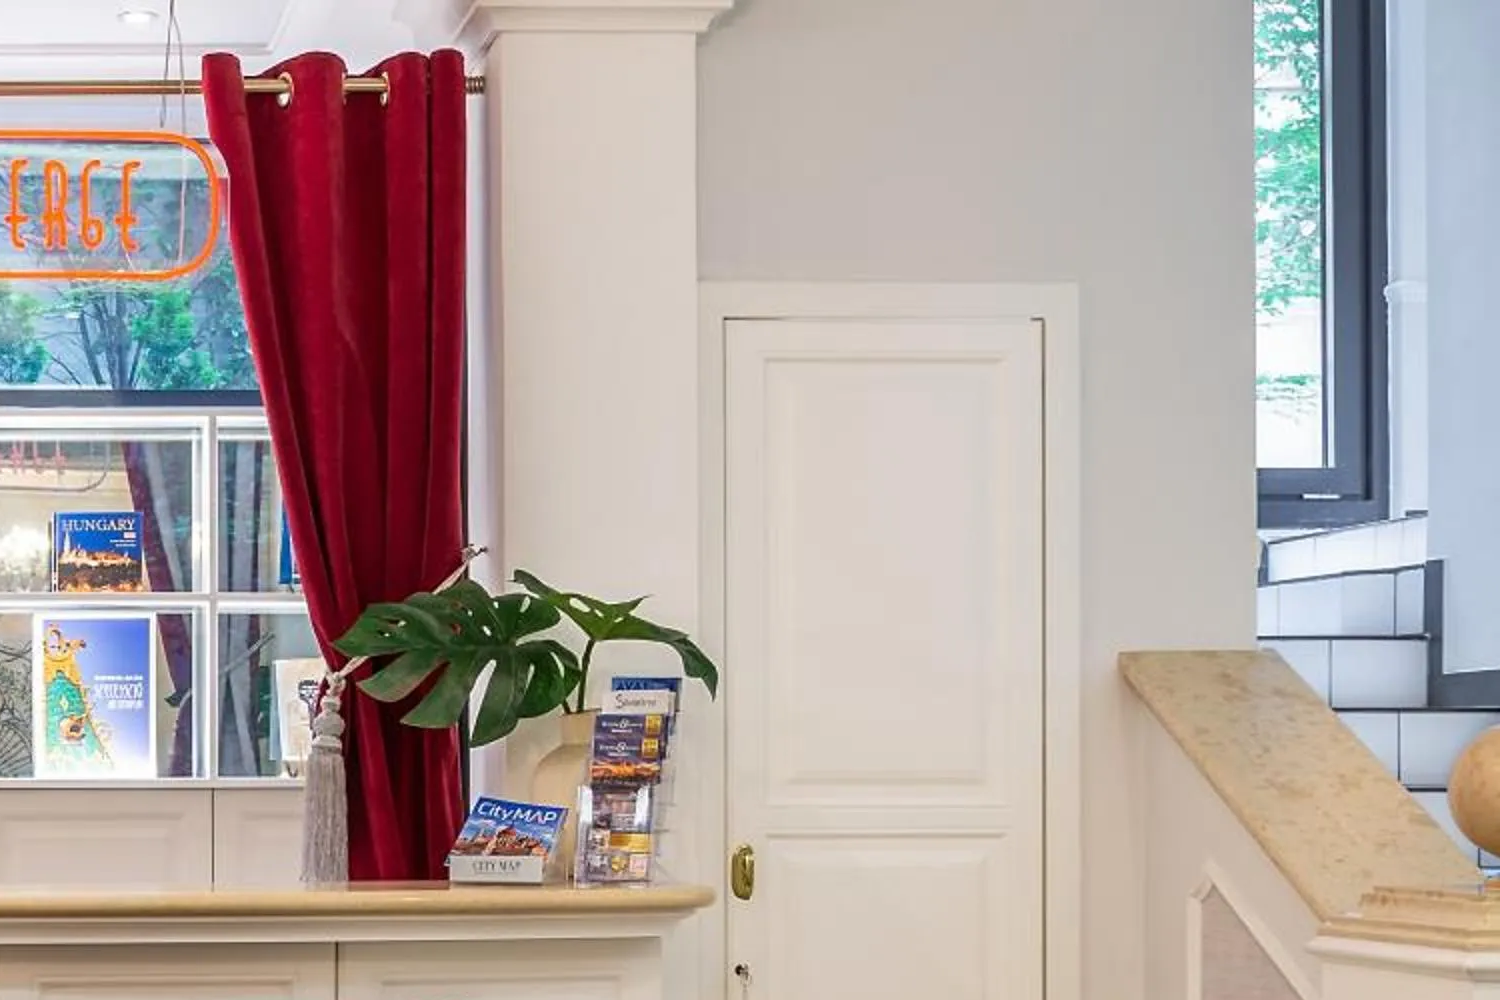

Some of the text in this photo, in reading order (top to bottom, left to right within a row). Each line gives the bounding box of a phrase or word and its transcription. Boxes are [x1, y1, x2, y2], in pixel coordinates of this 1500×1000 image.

[62, 519, 136, 531] HUNGARY
[472, 861, 522, 872] CITY MAP
